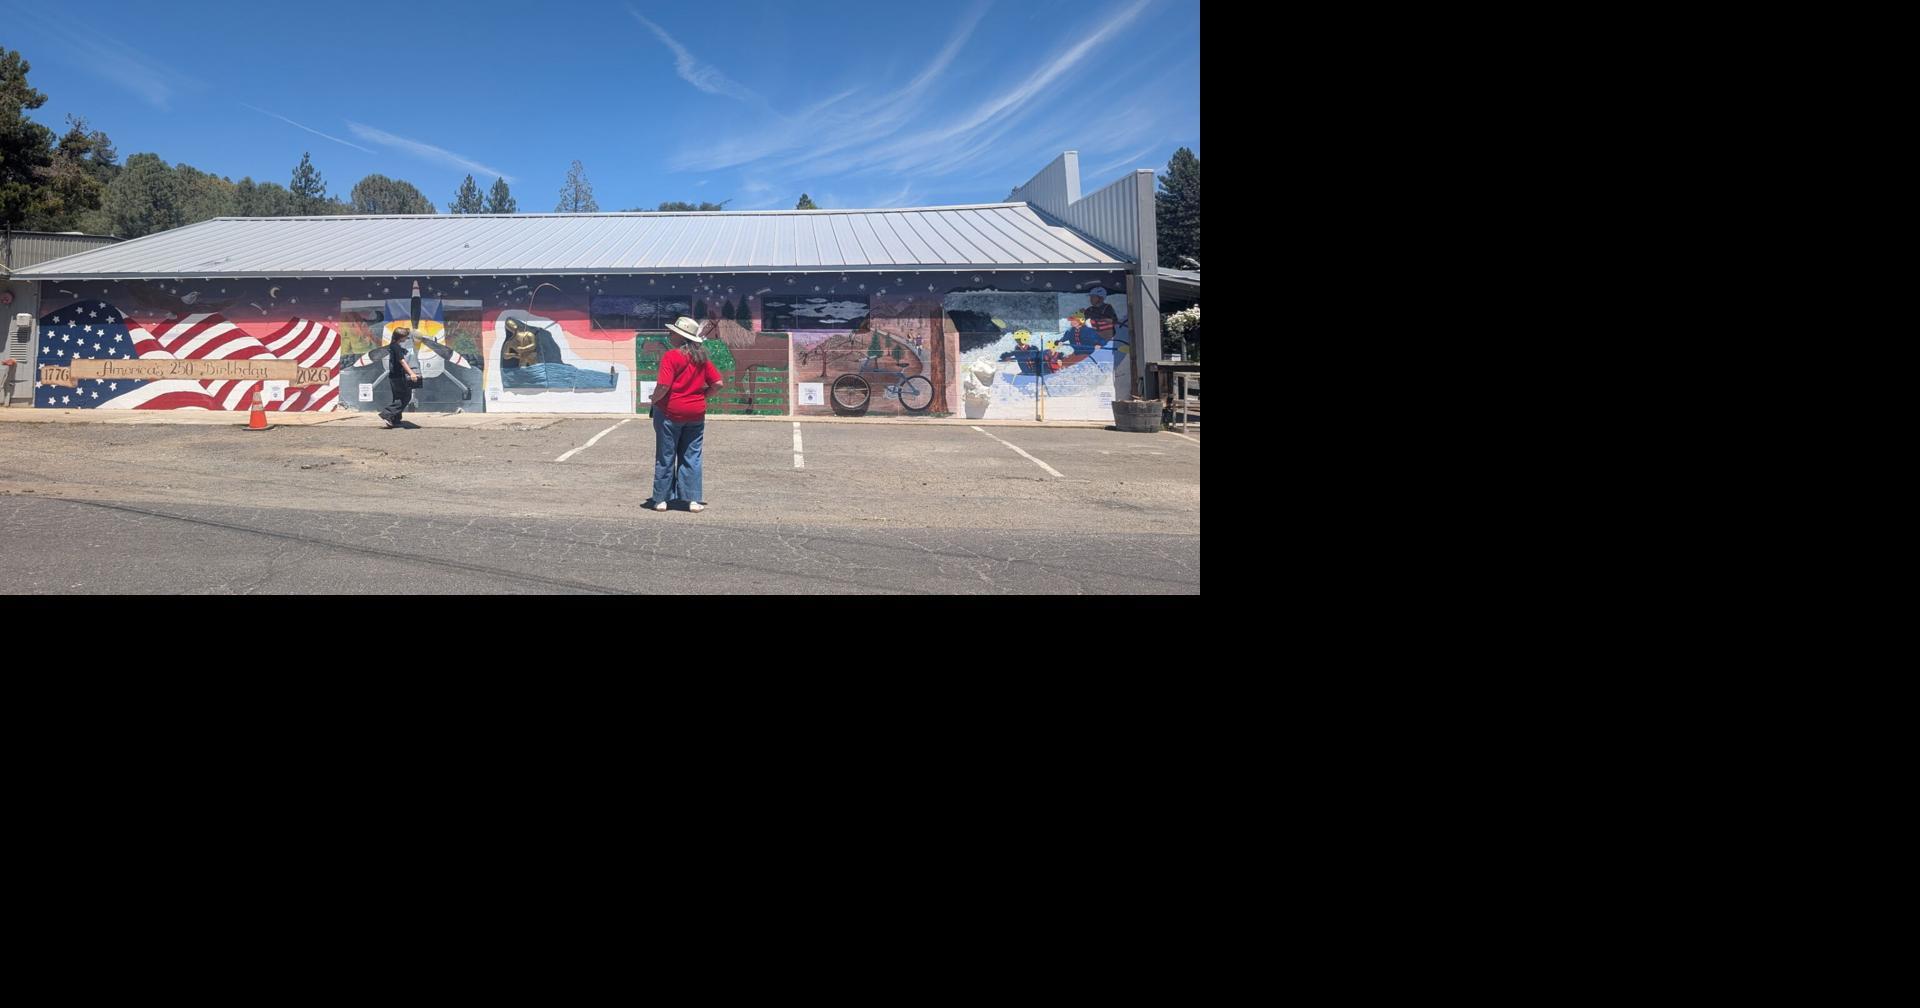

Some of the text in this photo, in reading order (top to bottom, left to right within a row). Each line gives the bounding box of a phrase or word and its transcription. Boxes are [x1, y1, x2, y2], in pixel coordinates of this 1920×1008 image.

[44, 368, 70, 381] 1776
[96, 361, 269, 379] America's 250 Birthday
[296, 368, 328, 384] 2026
